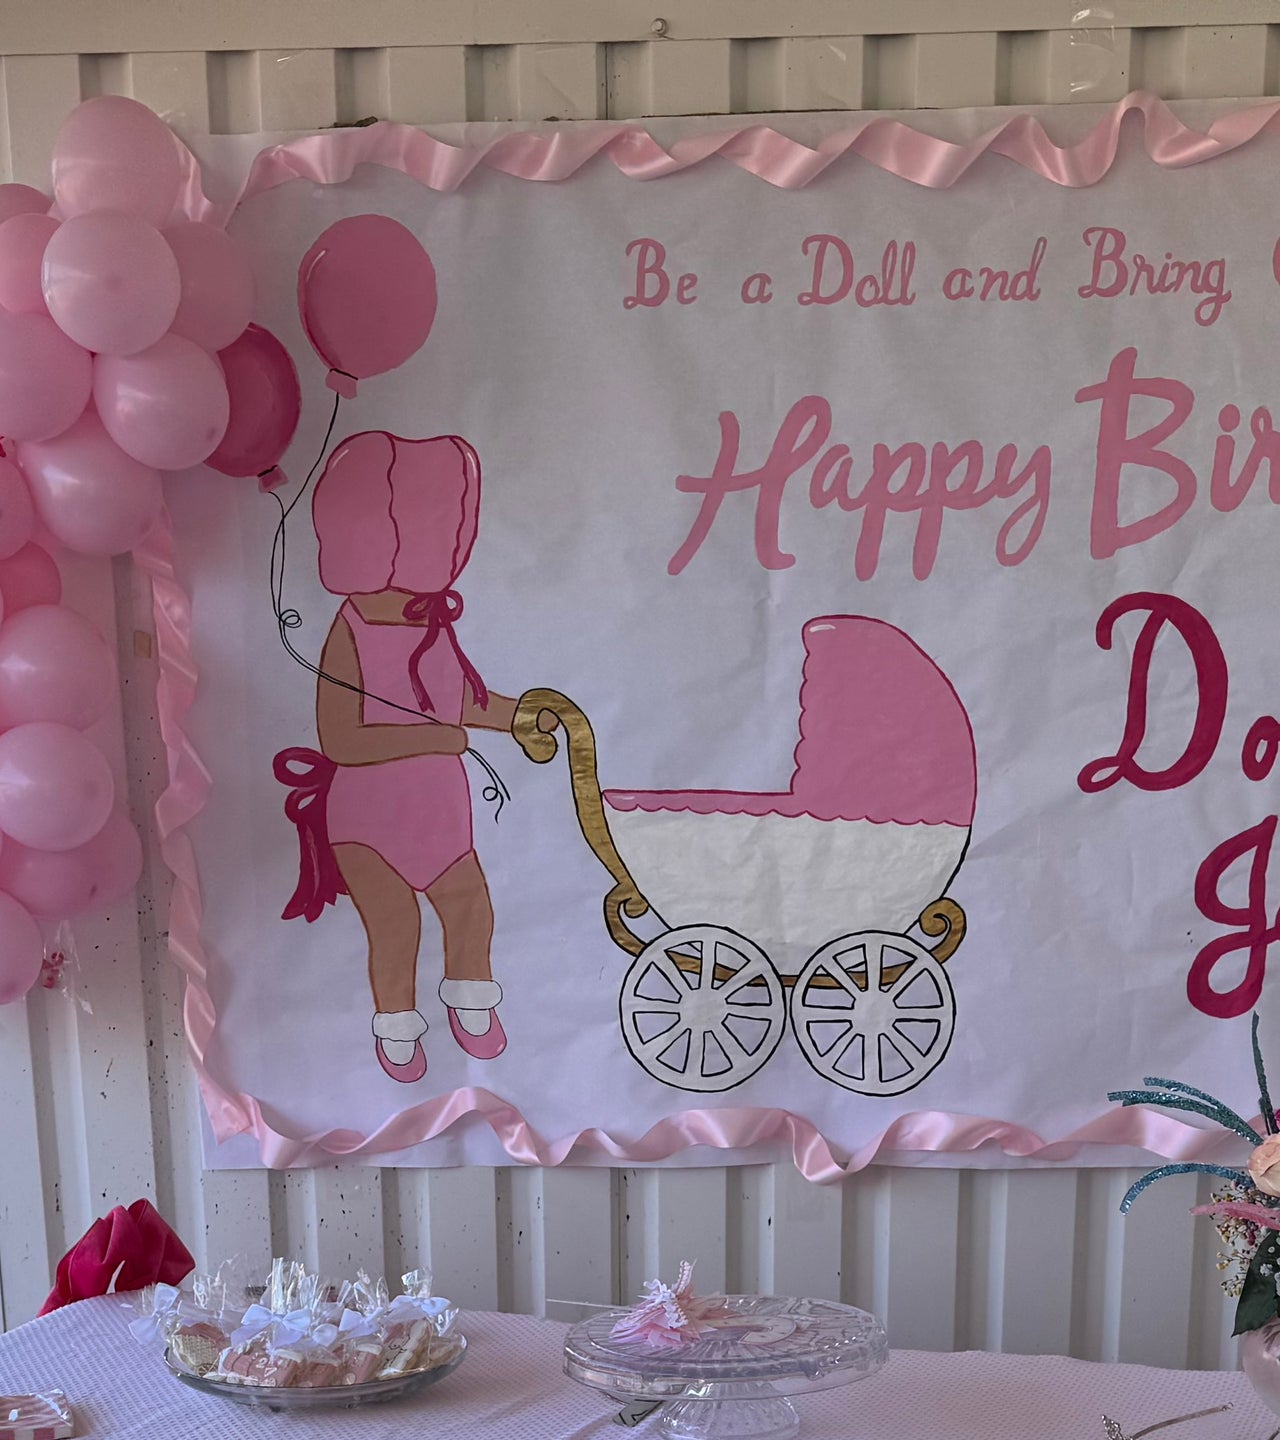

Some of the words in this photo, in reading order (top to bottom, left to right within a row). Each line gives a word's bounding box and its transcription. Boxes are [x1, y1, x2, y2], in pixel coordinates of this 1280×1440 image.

[623, 238, 698, 309] Be
[740, 272, 773, 304] a
[797, 234, 917, 307] Doll
[942, 237, 1045, 302] and
[1077, 226, 1233, 327] Bring
[666, 394, 1052, 582] Happy
